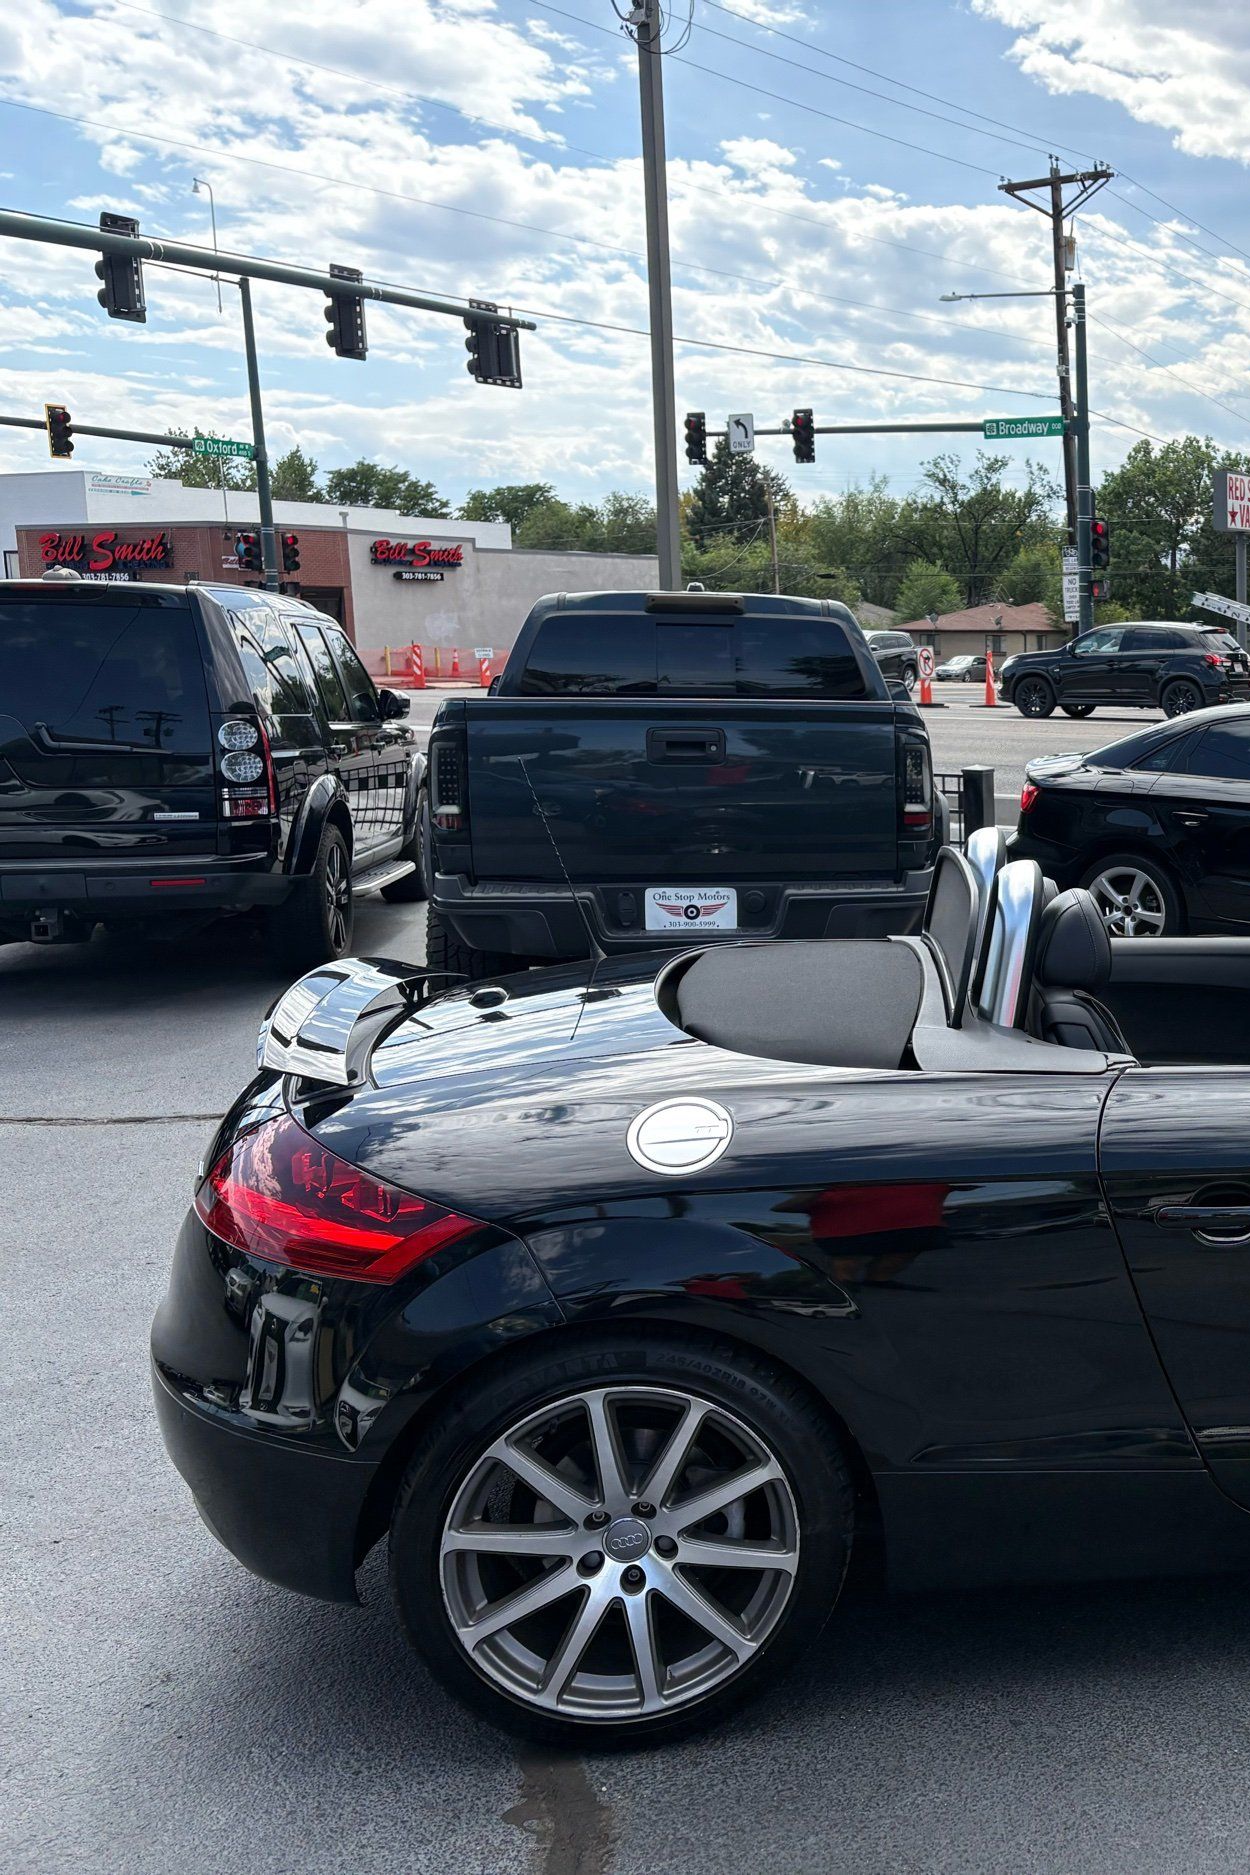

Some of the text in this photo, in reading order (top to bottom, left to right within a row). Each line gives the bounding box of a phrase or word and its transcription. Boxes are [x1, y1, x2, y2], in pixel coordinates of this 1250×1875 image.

[999, 421, 1048, 435] Broadway
[206, 440, 237, 455] Oxford
[732, 440, 751, 449] ONLY
[1228, 476, 1246, 502] RED
[39, 531, 166, 571] Bill Smith
[375, 538, 464, 567] Bill Smith
[81, 572, 130, 581] 303-781-7856
[401, 572, 442, 580] 303-781-7856
[1067, 578, 1077, 586] NO
[653, 891, 731, 903] One Stop Motors
[668, 920, 716, 928] 303-900-5999
